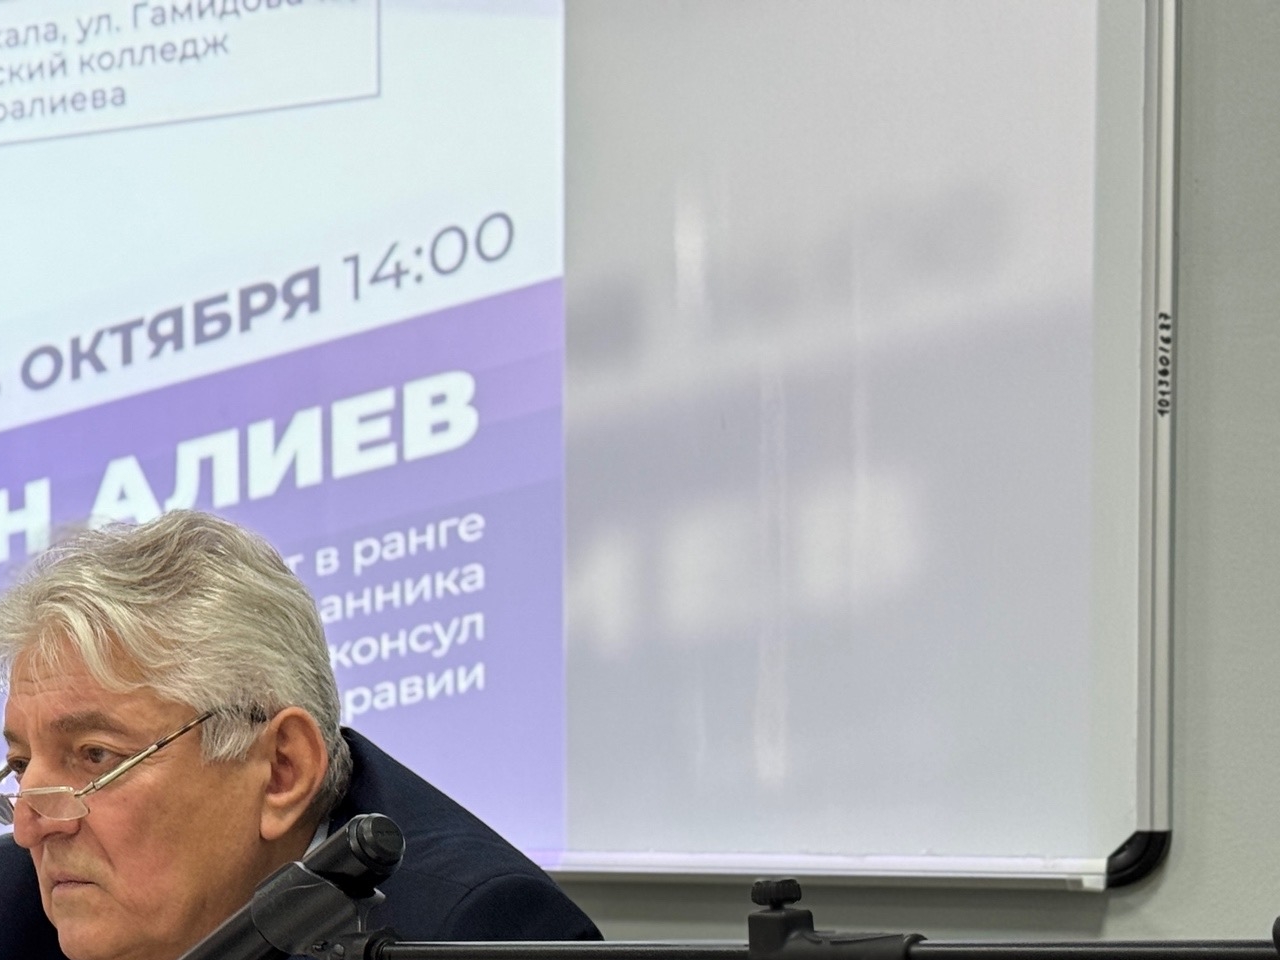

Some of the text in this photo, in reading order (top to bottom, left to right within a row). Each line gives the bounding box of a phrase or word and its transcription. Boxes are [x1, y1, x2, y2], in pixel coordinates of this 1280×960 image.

[77, 13, 120, 44] ул.
[80, 33, 230, 73] колледж
[20, 265, 321, 390] ОКТЯБРЯ
[343, 211, 515, 301] 14:00
[88, 370, 479, 532] АЛИЕВ
[316, 547, 340, 576] в
[353, 512, 485, 576] ранге
[320, 562, 485, 624] анника
[343, 662, 485, 724] равии
